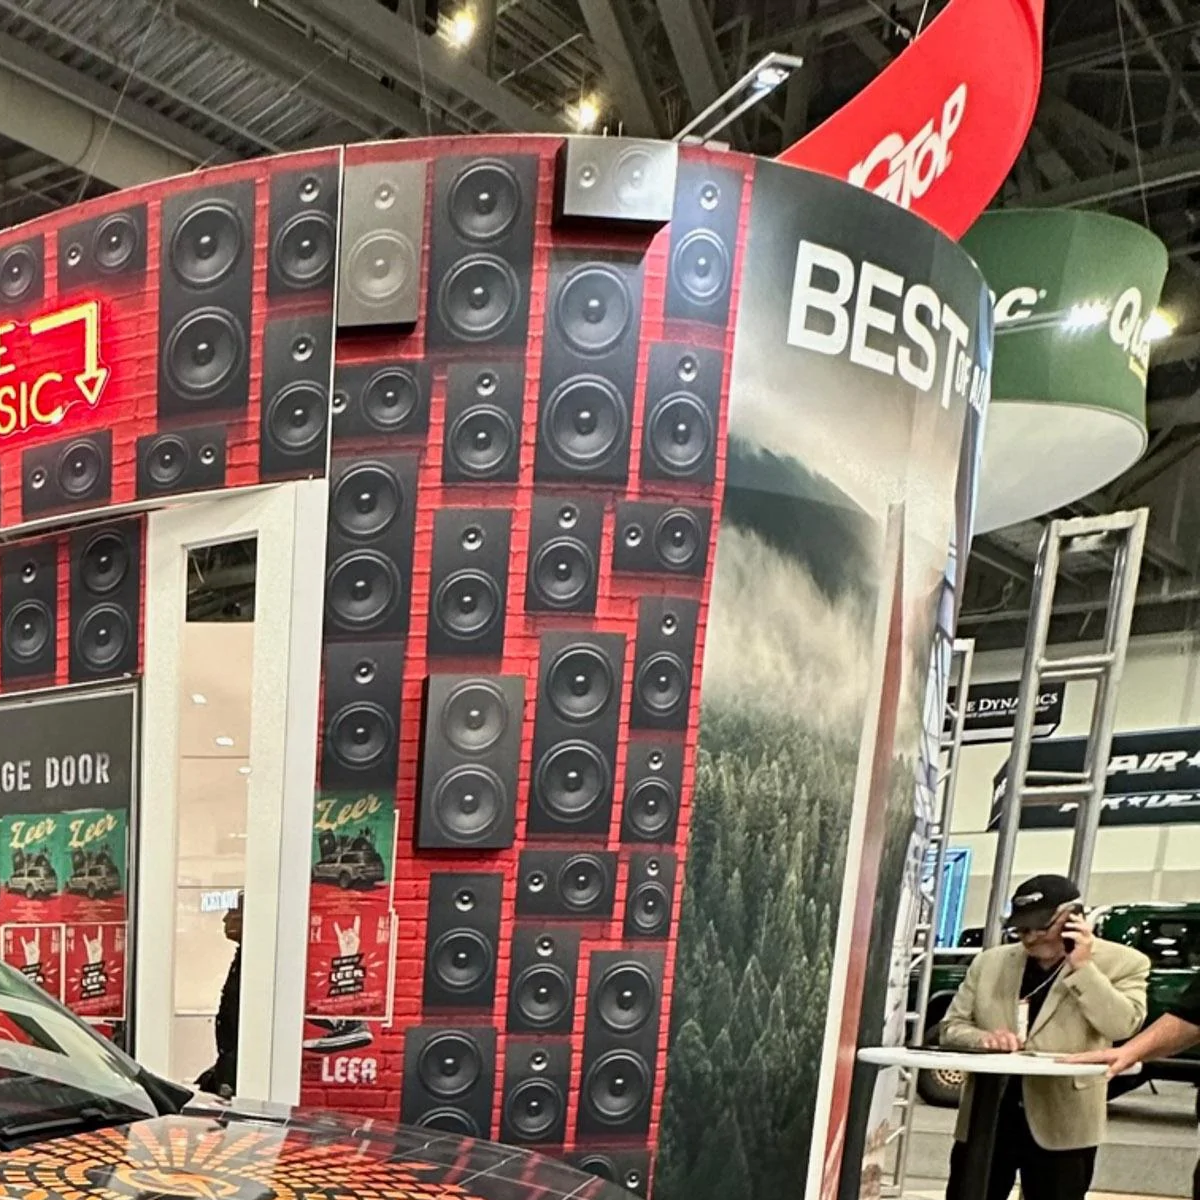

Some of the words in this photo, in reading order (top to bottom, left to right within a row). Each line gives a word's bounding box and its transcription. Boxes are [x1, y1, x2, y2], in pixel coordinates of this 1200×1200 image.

[787, 239, 969, 411] BEST
[45, 752, 111, 789] DOOR
[68, 811, 119, 848] Leer
[314, 792, 382, 831] Leer
[9, 814, 58, 850] Leer
